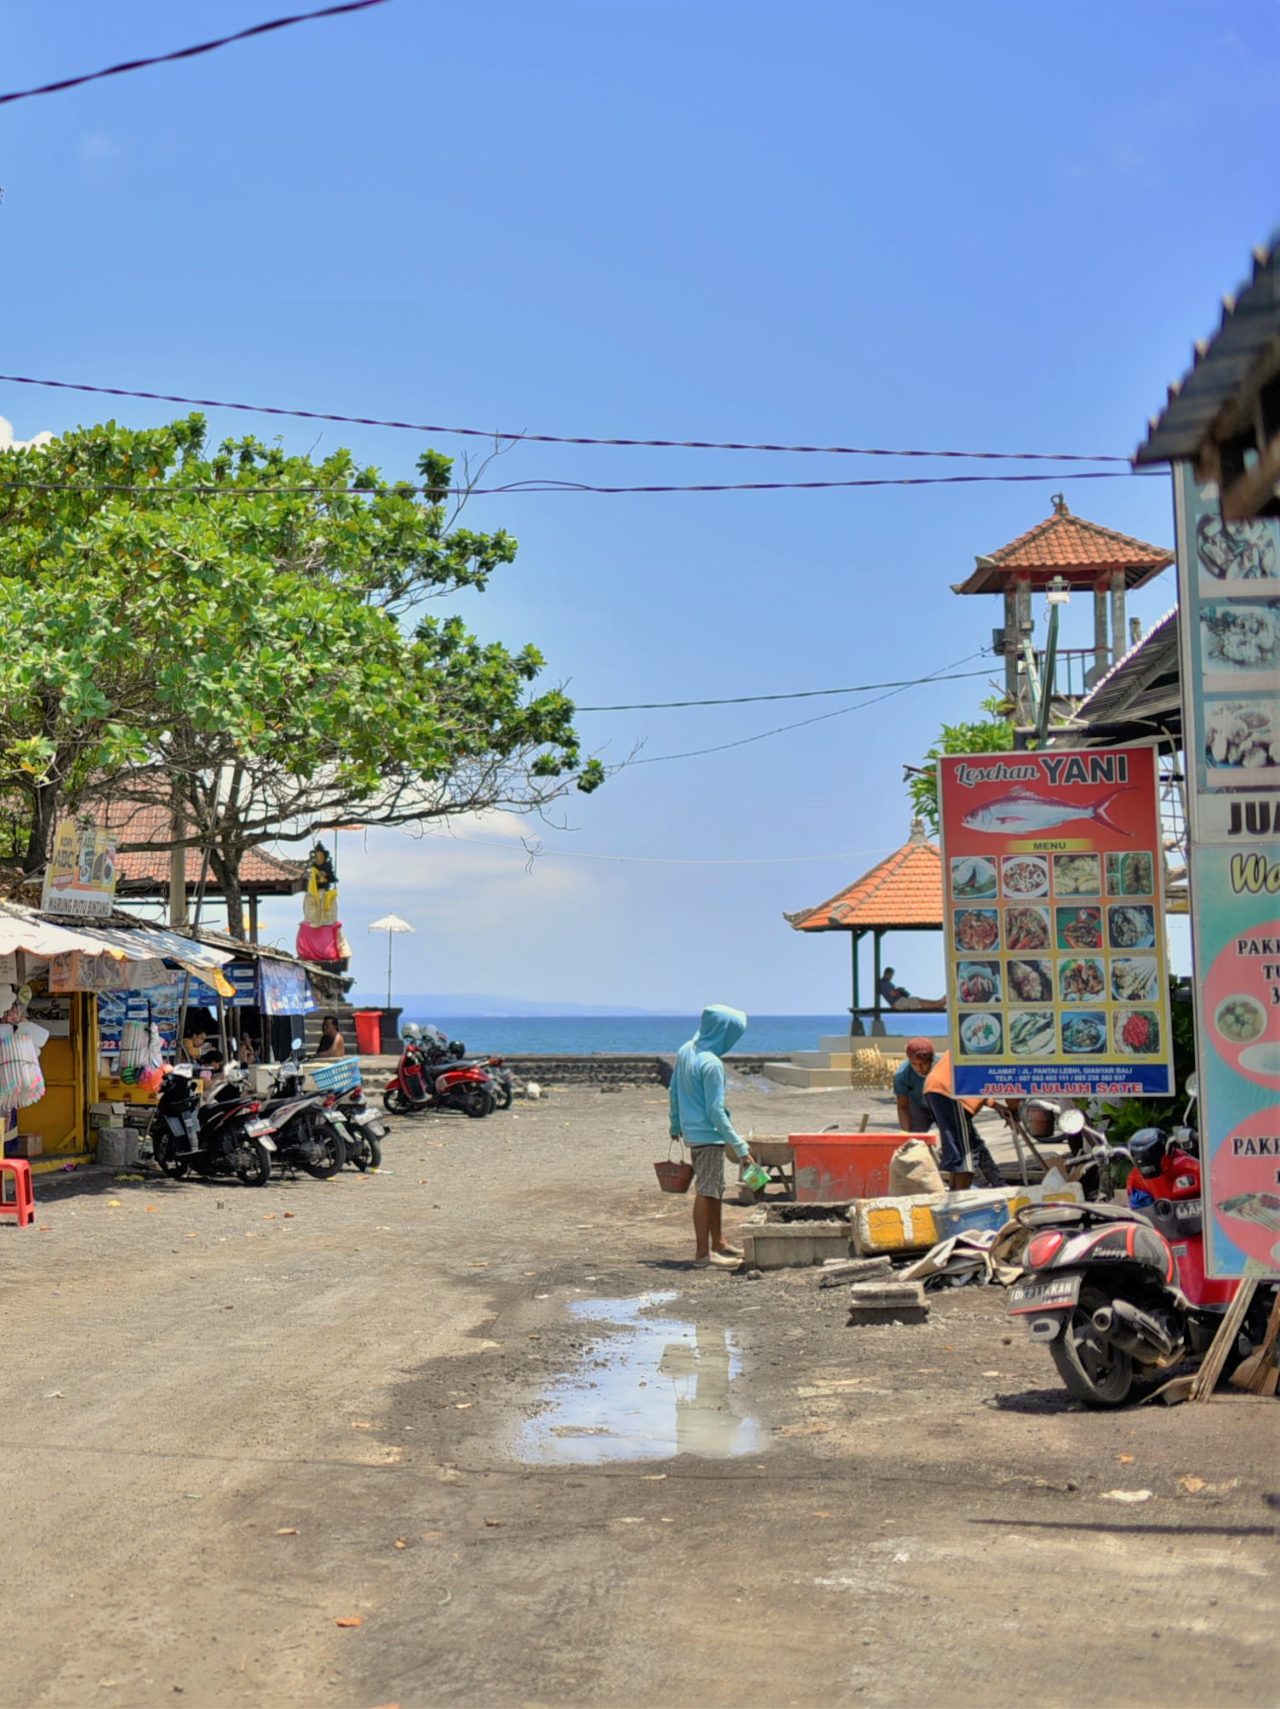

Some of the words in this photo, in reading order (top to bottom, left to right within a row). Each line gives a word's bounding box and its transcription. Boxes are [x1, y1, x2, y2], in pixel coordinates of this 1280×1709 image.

[1040, 754, 1128, 785] YANI
[1033, 842, 1067, 850] MENU
[980, 1083, 1027, 1095] JUAL
[1031, 1082, 1091, 1094] LULUH
[1096, 1082, 1143, 1093] SATE
